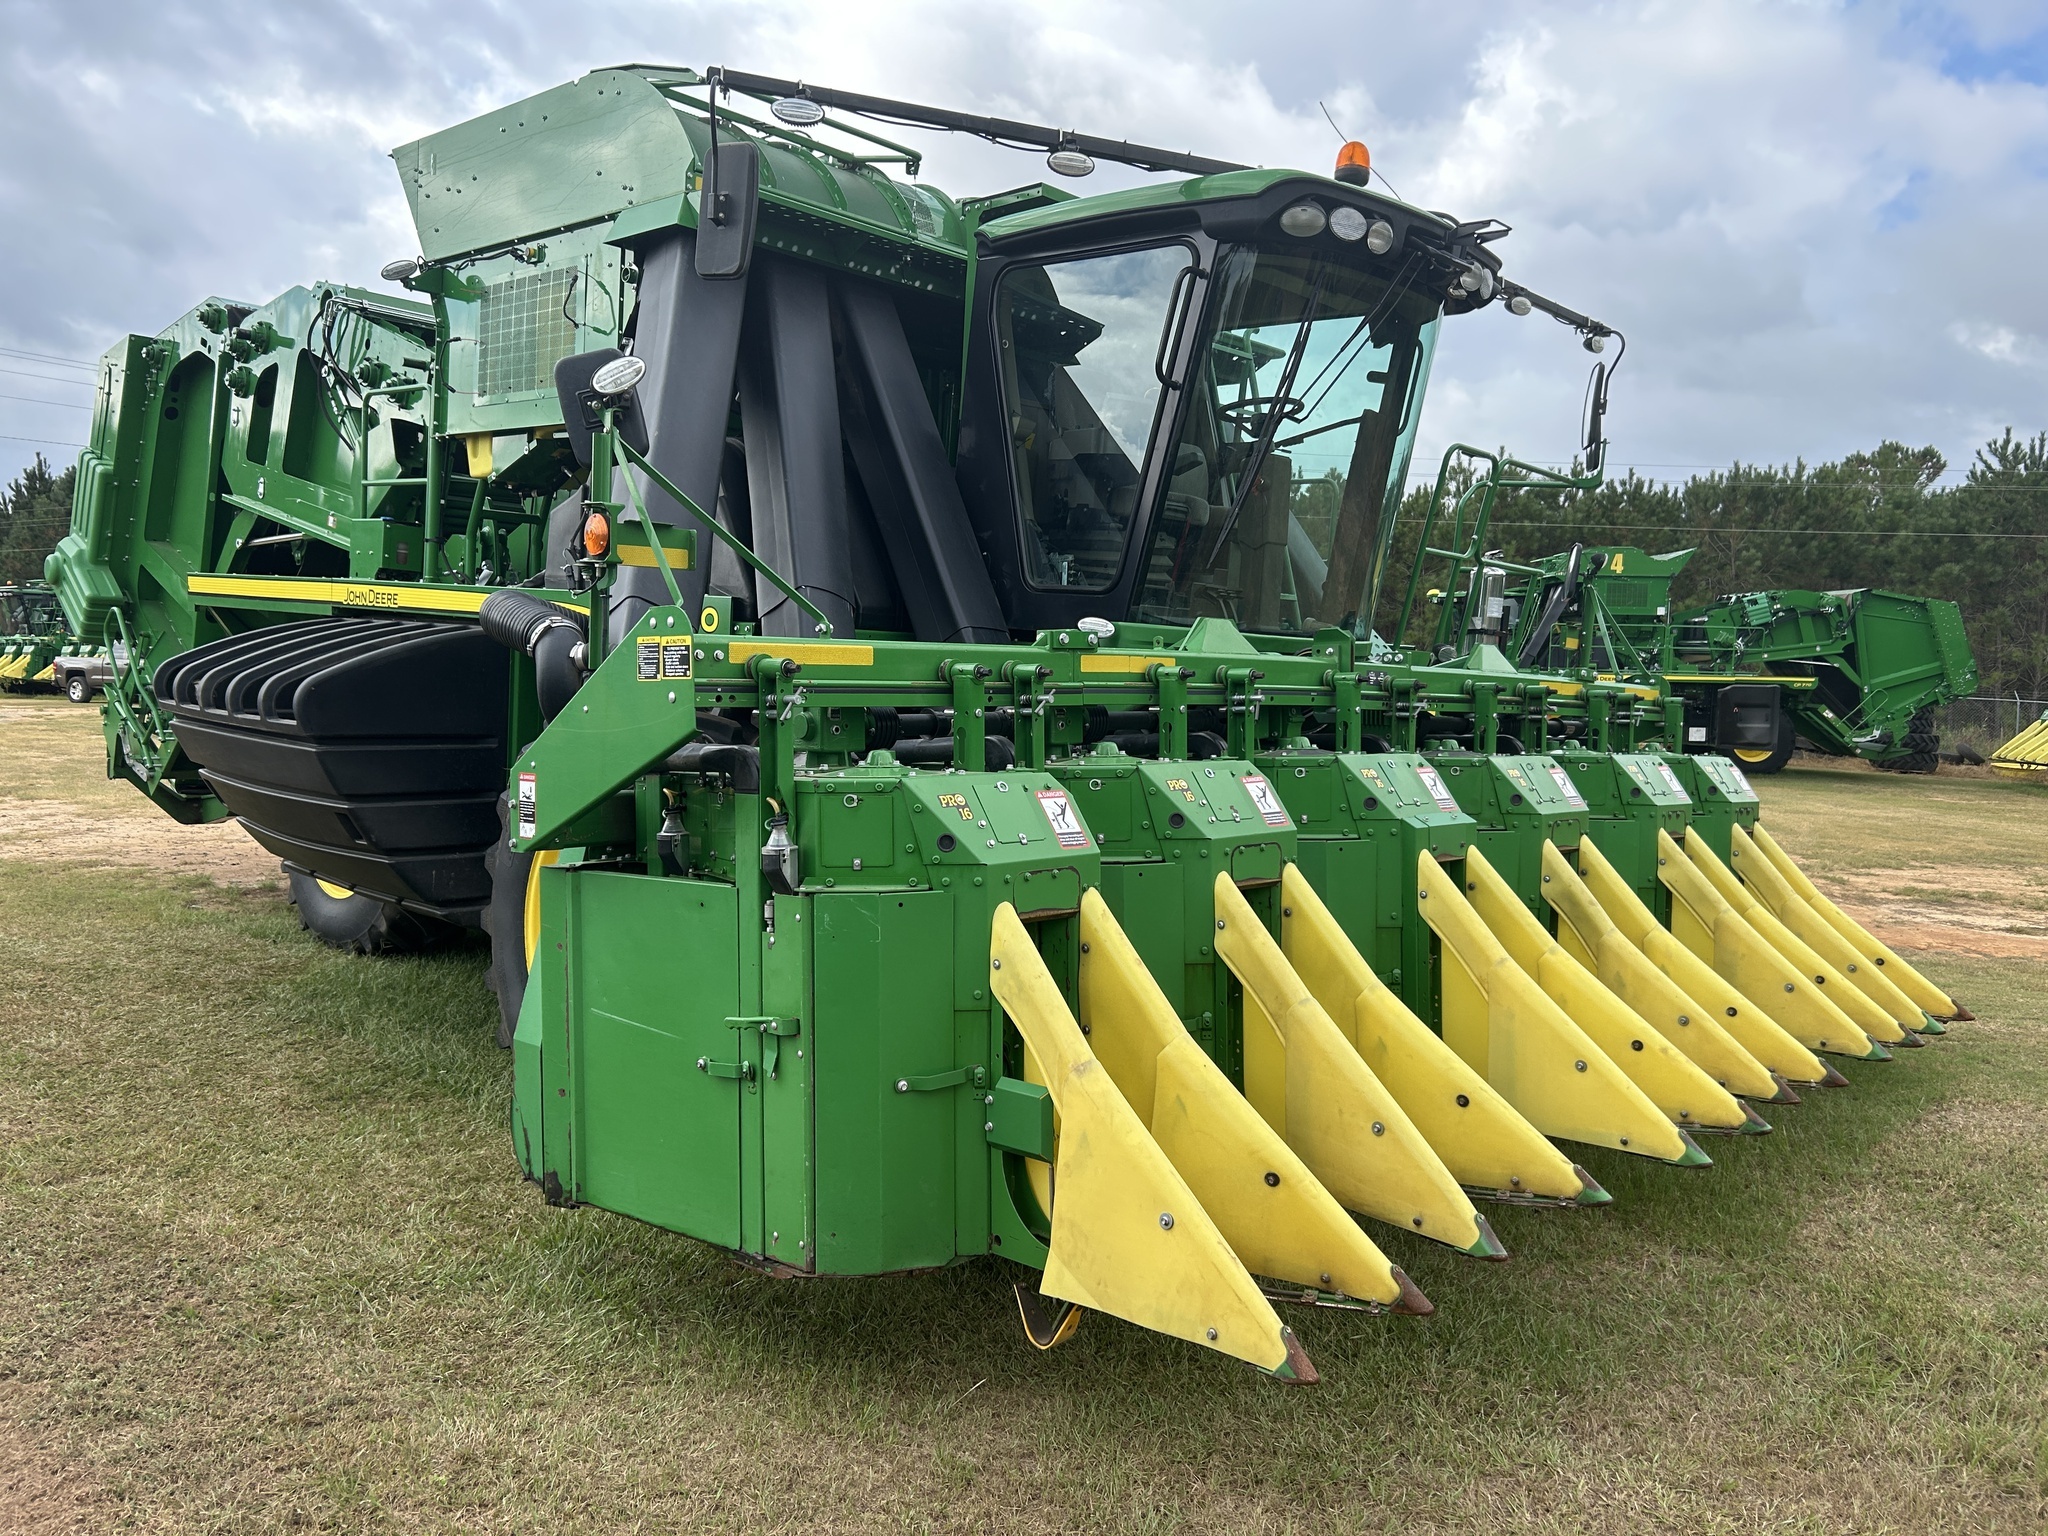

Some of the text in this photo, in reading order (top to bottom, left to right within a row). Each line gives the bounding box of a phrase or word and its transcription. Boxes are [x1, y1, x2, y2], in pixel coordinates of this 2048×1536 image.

[1610, 553, 1624, 573] 4
[344, 587, 398, 606] JOHN DEERE
[1166, 779, 1188, 790] PRO
[938, 793, 966, 807] PRO
[1042, 790, 1065, 798] DANGER
[1183, 790, 1195, 802] 16
[958, 807, 973, 821] 16
